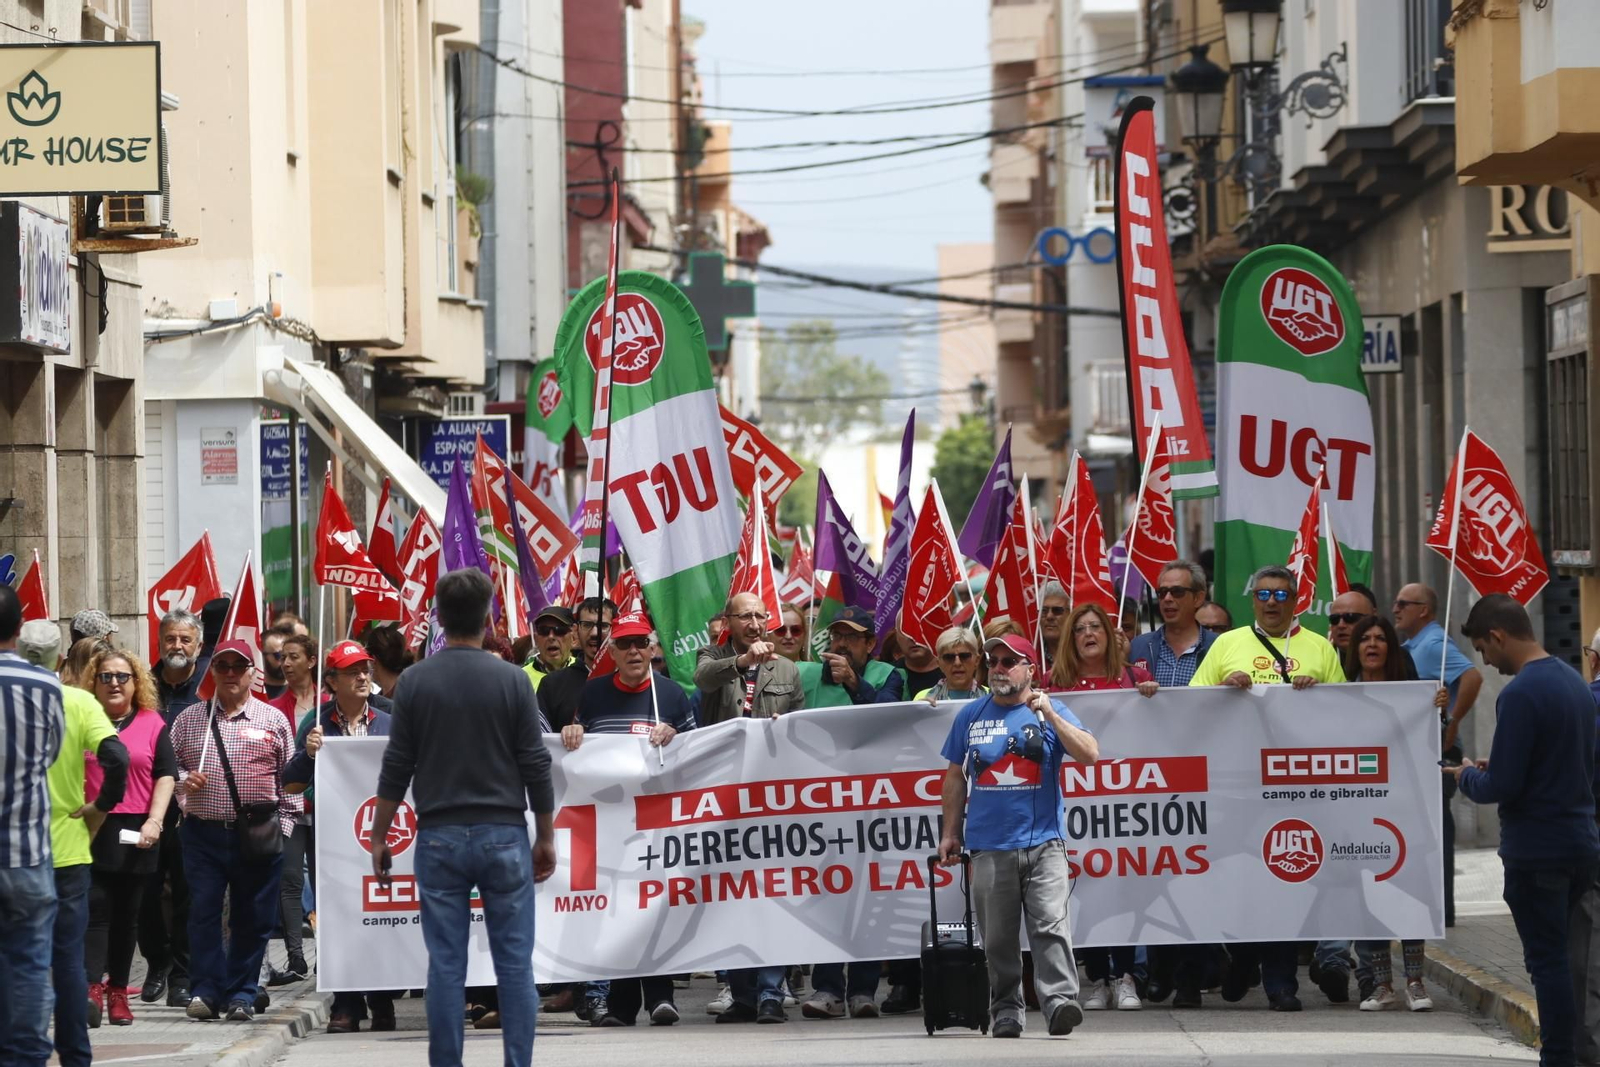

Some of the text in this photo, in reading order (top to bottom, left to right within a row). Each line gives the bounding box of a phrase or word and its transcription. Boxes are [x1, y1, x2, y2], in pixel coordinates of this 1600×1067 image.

[43, 136, 152, 166] HOUSE
[1271, 277, 1333, 321] UGT
[448, 422, 494, 435] ALIANZA
[435, 438, 476, 455] ESPAÑO
[1239, 414, 1371, 500] UGT
[1461, 473, 1525, 545] UGT
[1266, 753, 1356, 776] CCOO
[671, 759, 1168, 822] LA LUCHA CNÚA
[1262, 787, 1389, 801] campo de gibraltar
[361, 804, 408, 830] UT
[1064, 795, 1208, 840] OHESIÓN
[553, 804, 597, 892] 1
[1270, 829, 1314, 854] UGT
[1330, 841, 1391, 855] Andalucía
[638, 845, 1210, 910] PRIMERO LAS SONAS
[554, 894, 608, 914] MAYO
[362, 914, 409, 928] campo
